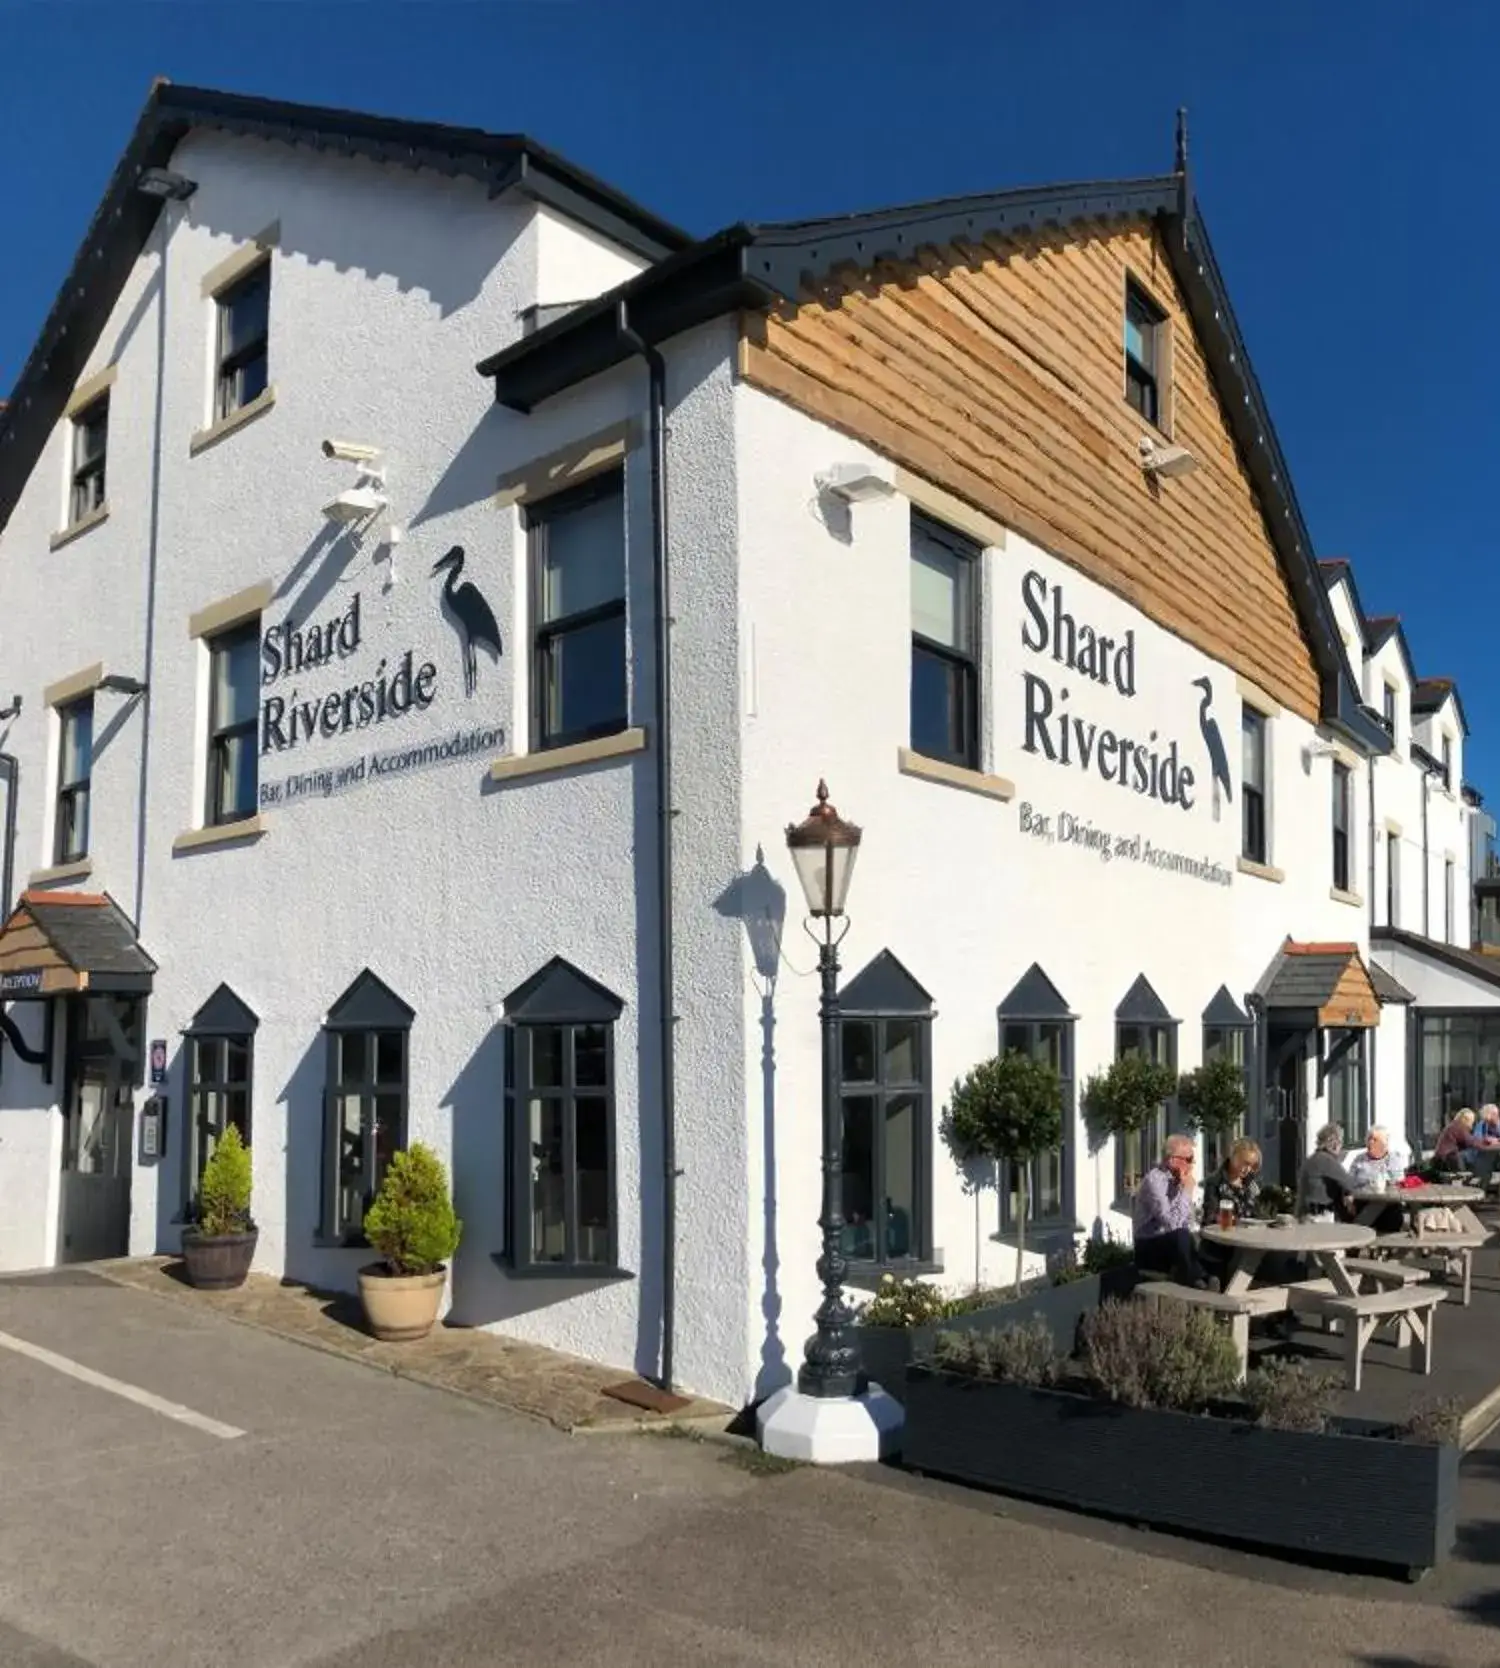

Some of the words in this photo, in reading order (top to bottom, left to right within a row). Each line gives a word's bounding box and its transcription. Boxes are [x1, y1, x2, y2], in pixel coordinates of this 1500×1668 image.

[261, 593, 362, 684] Shard
[1021, 570, 1135, 697] Shard
[261, 651, 436, 754] Riverside
[1021, 670, 1195, 810] Riverside
[285, 770, 333, 798] Dining
[335, 755, 365, 786] and
[368, 728, 505, 776] Accommodation
[1019, 801, 1054, 845] Bar,
[1057, 811, 1112, 862] Dining
[1113, 833, 1140, 861] and
